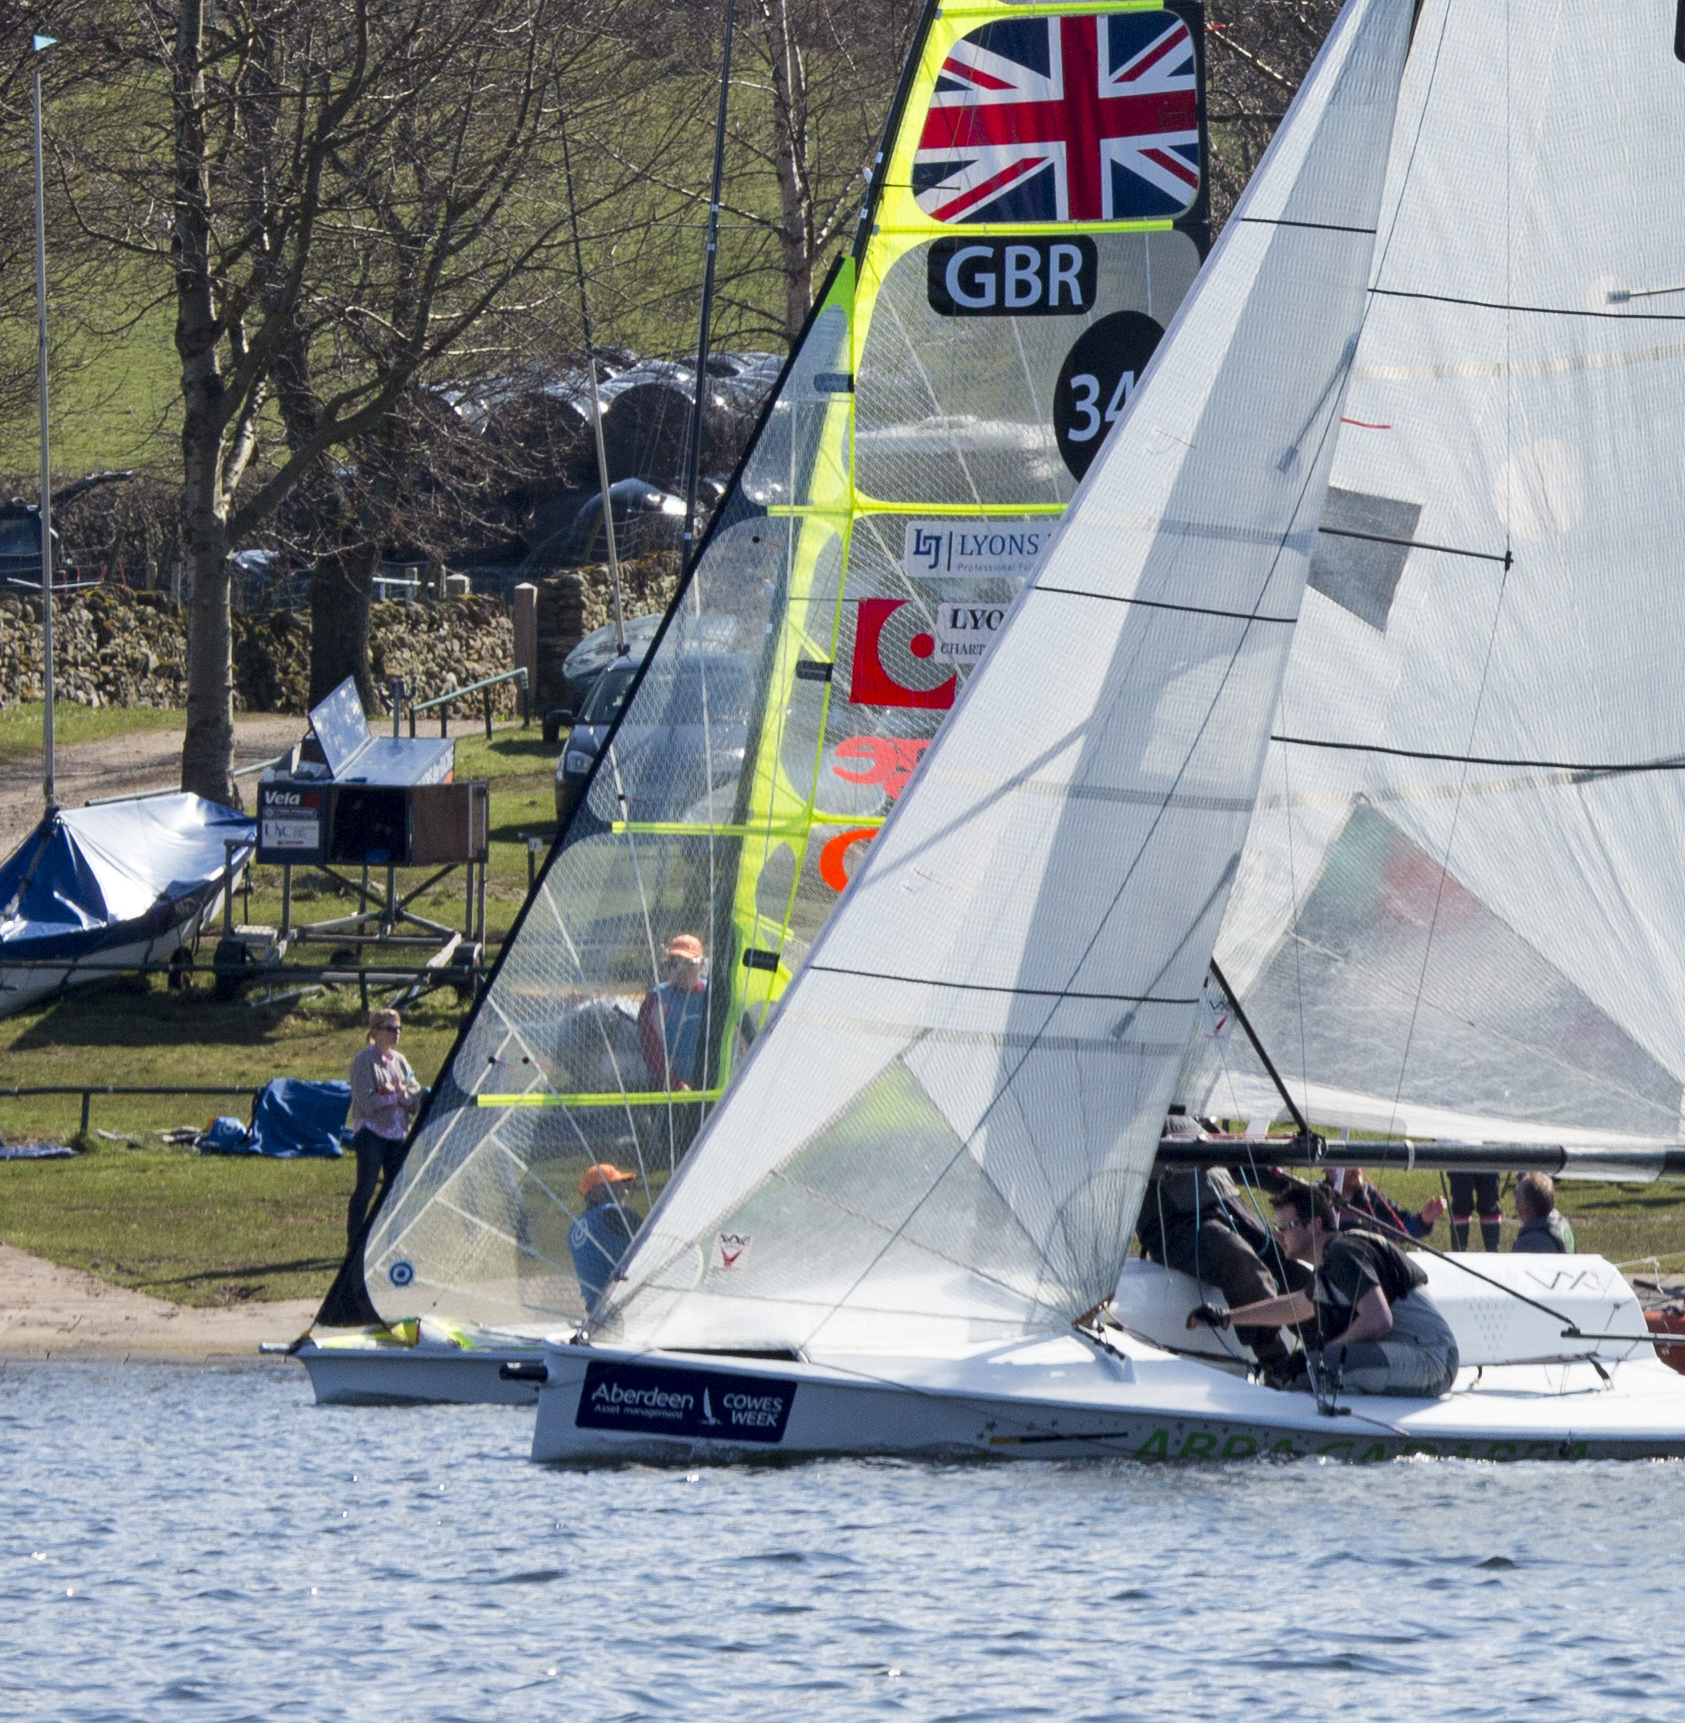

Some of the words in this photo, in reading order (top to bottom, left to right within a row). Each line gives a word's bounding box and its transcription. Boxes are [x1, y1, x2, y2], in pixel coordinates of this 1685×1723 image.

[945, 243, 1084, 309] GBR
[958, 532, 1040, 557] LYONS
[956, 562, 1016, 574] Professional
[264, 790, 301, 806] Vela
[591, 1382, 695, 1411] Aberdeen
[722, 1392, 784, 1413] COWES
[730, 1409, 780, 1428] WEEK
